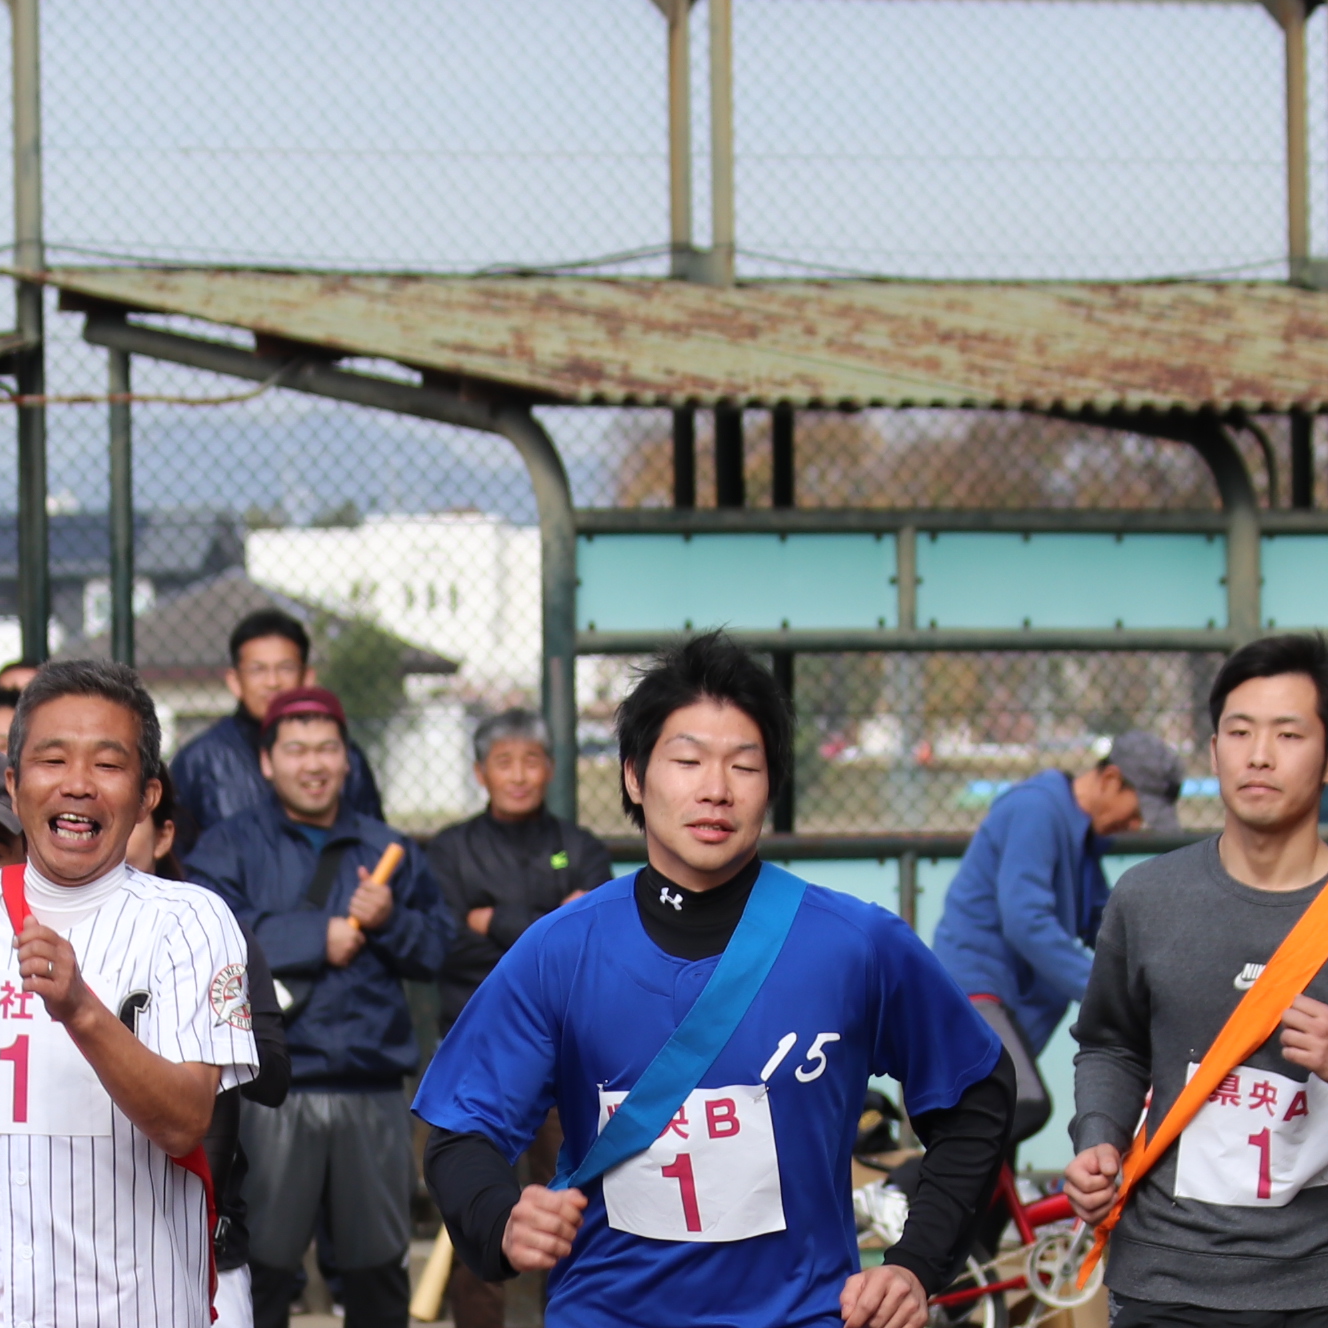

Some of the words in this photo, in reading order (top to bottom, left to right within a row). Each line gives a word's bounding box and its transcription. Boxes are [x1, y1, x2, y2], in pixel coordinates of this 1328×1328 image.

[210, 964, 243, 1005] MARINES
[760, 1032, 841, 1083] 15
[661, 1153, 703, 1232] 1
[1248, 1126, 1271, 1199] 1
